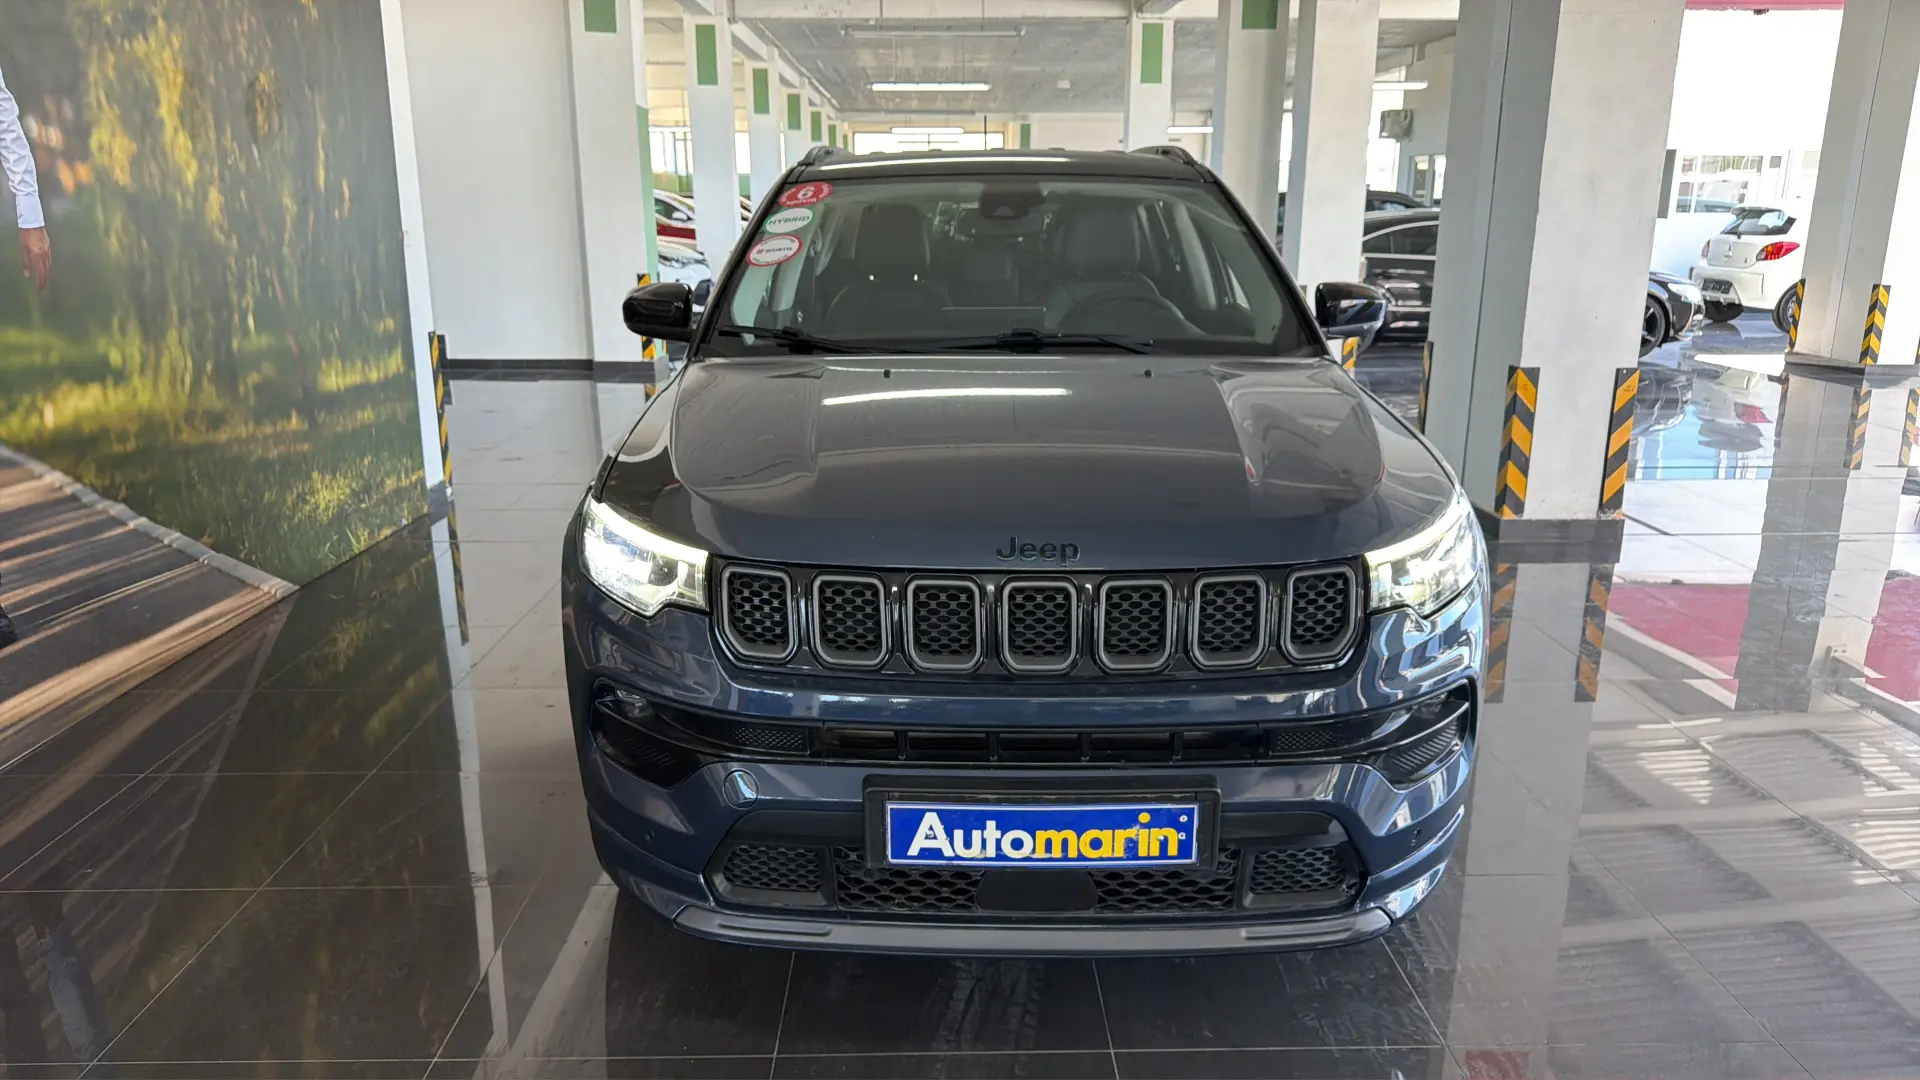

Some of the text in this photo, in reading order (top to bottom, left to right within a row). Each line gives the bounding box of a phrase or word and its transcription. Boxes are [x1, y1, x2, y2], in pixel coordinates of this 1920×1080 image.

[797, 186, 815, 199] 6
[769, 216, 810, 224] HYBRID
[996, 536, 1080, 567] Jeep
[907, 812, 1179, 858] Automarin
